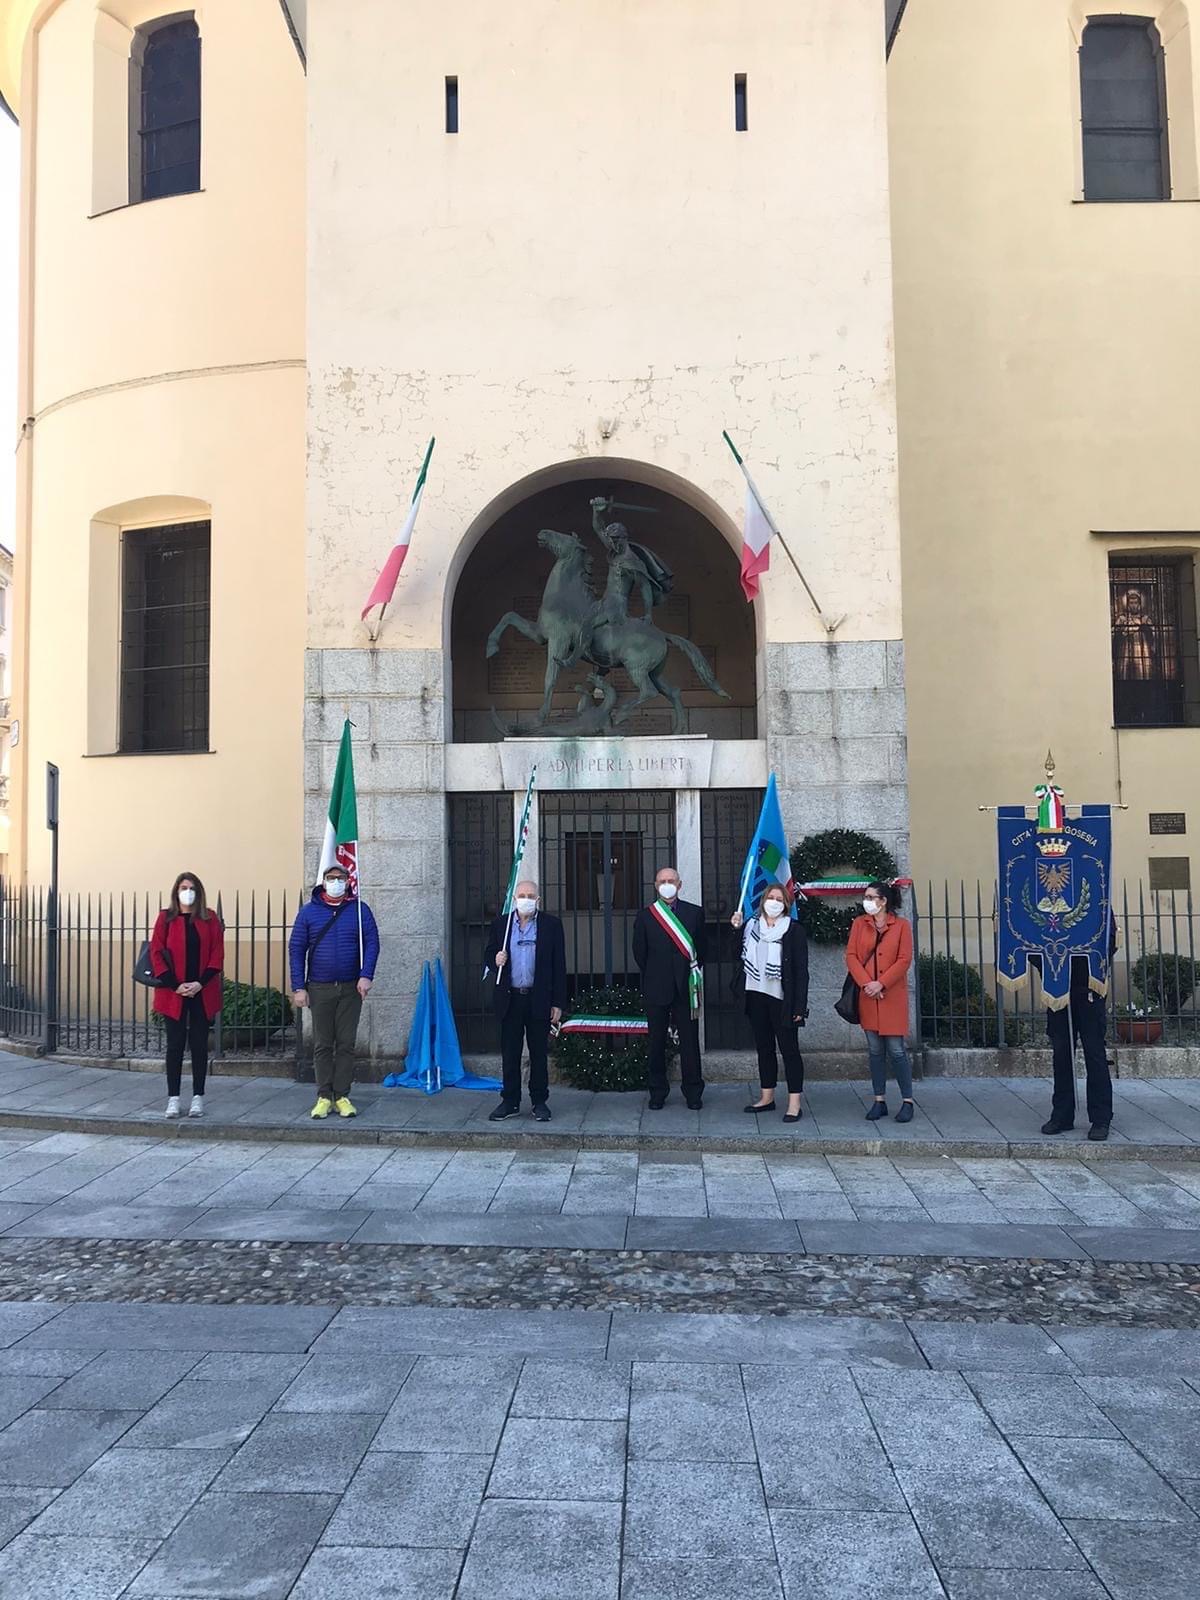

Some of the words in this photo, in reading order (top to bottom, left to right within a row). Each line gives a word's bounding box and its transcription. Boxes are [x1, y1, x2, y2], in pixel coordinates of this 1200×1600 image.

[588, 759, 615, 773] PER
[618, 758, 634, 771] LA
[1063, 825, 1099, 847] GOSESIA
